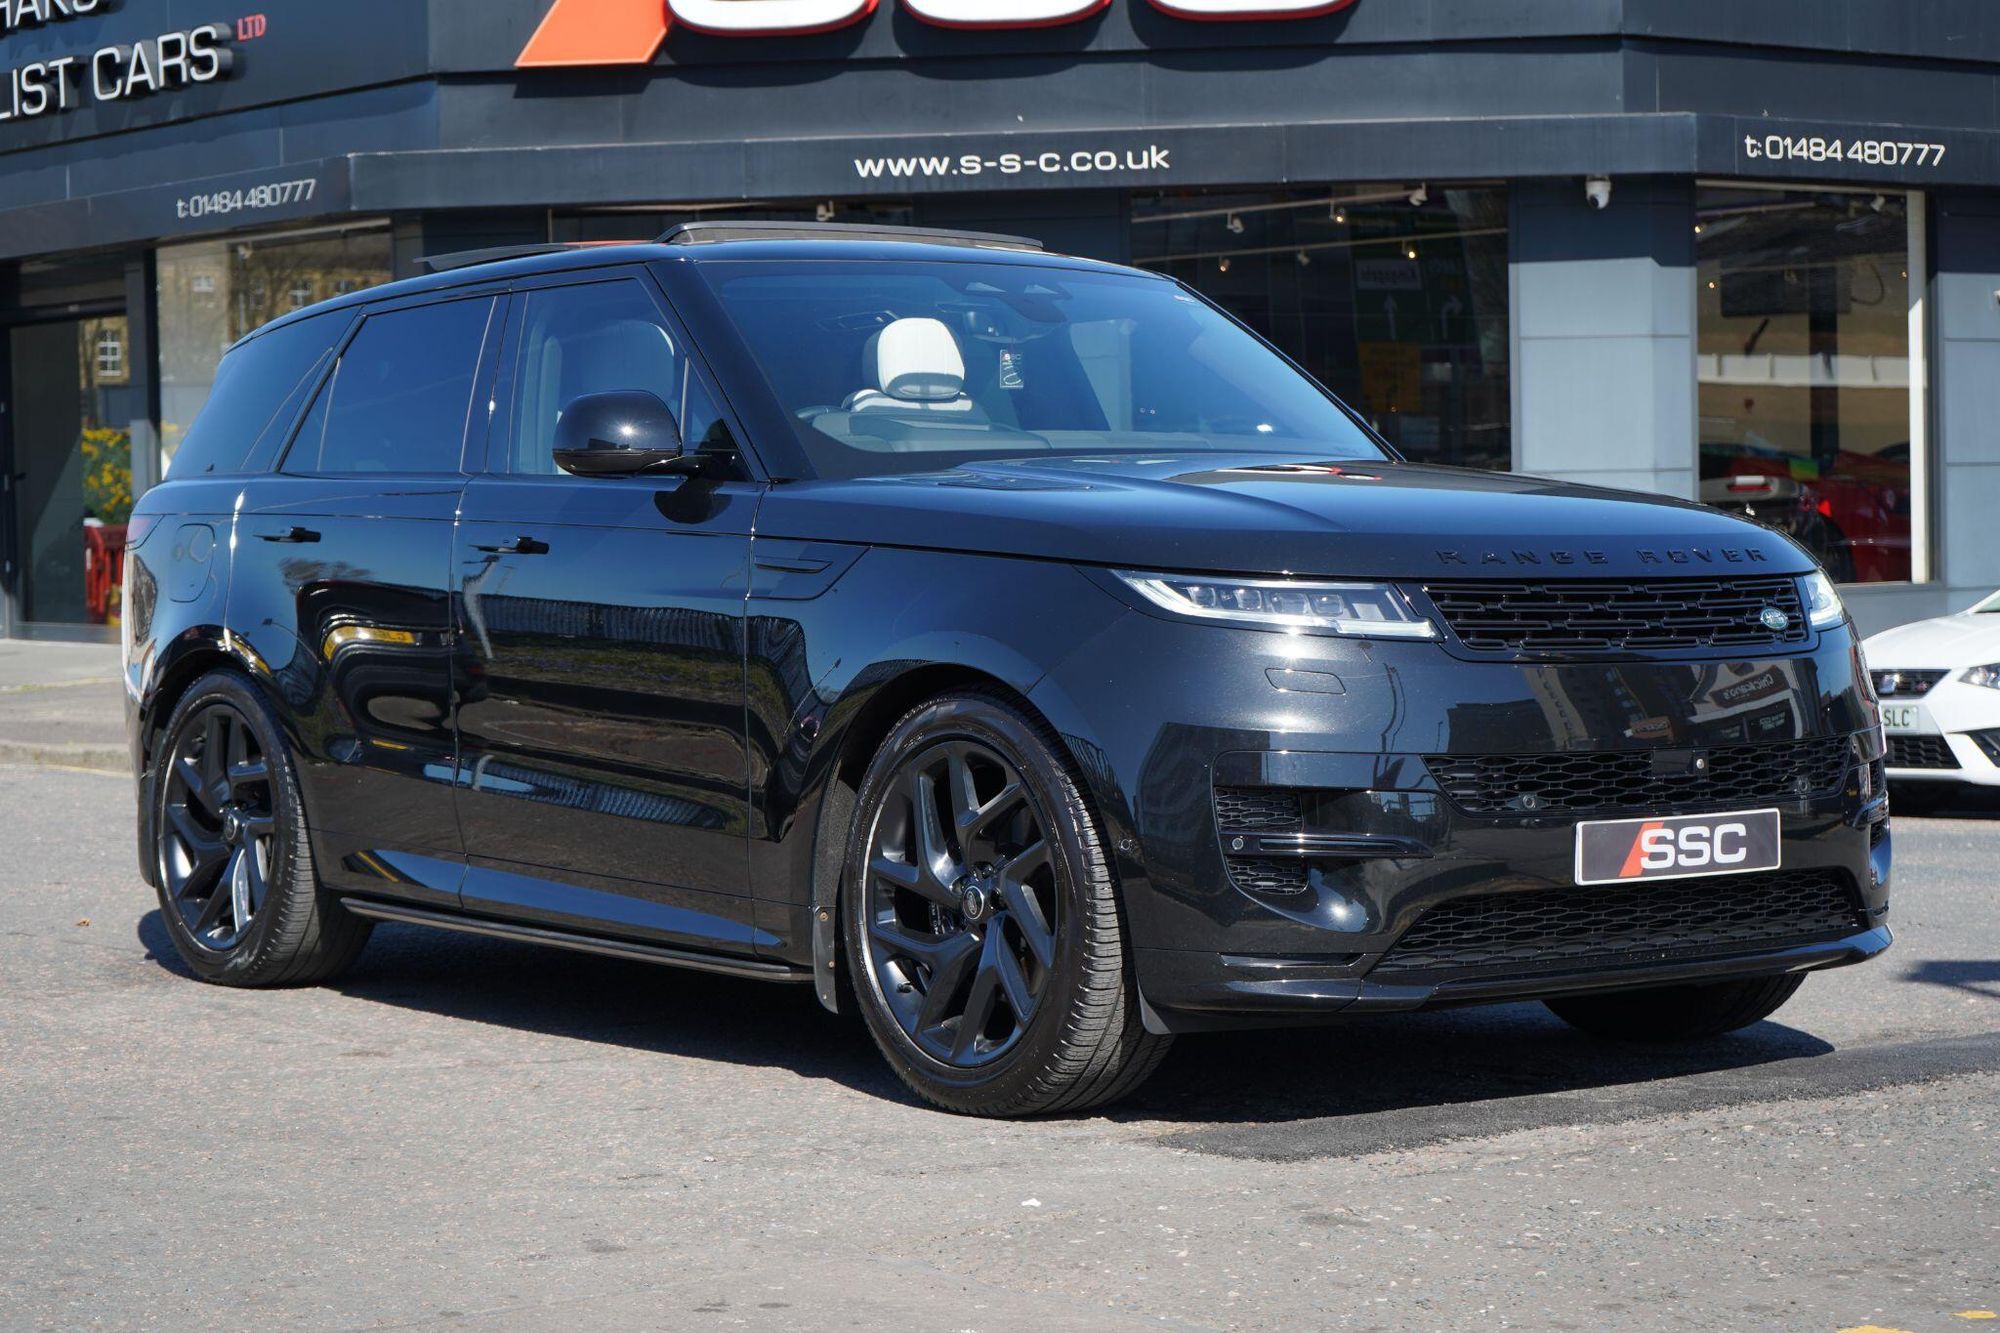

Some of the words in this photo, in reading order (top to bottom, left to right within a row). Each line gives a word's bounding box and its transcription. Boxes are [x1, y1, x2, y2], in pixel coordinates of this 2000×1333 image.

[236, 13, 267, 41] LTD
[92, 25, 220, 101] CARS
[853, 144, 1171, 178] www.s-s-c.co.uk
[1846, 139, 1946, 167] 480777
[243, 178, 317, 209] 480777
[1435, 549, 1608, 566] RANGE
[1635, 547, 1769, 565] ROVER
[1883, 708, 1910, 728] SLC
[1640, 822, 1747, 870] SSC
